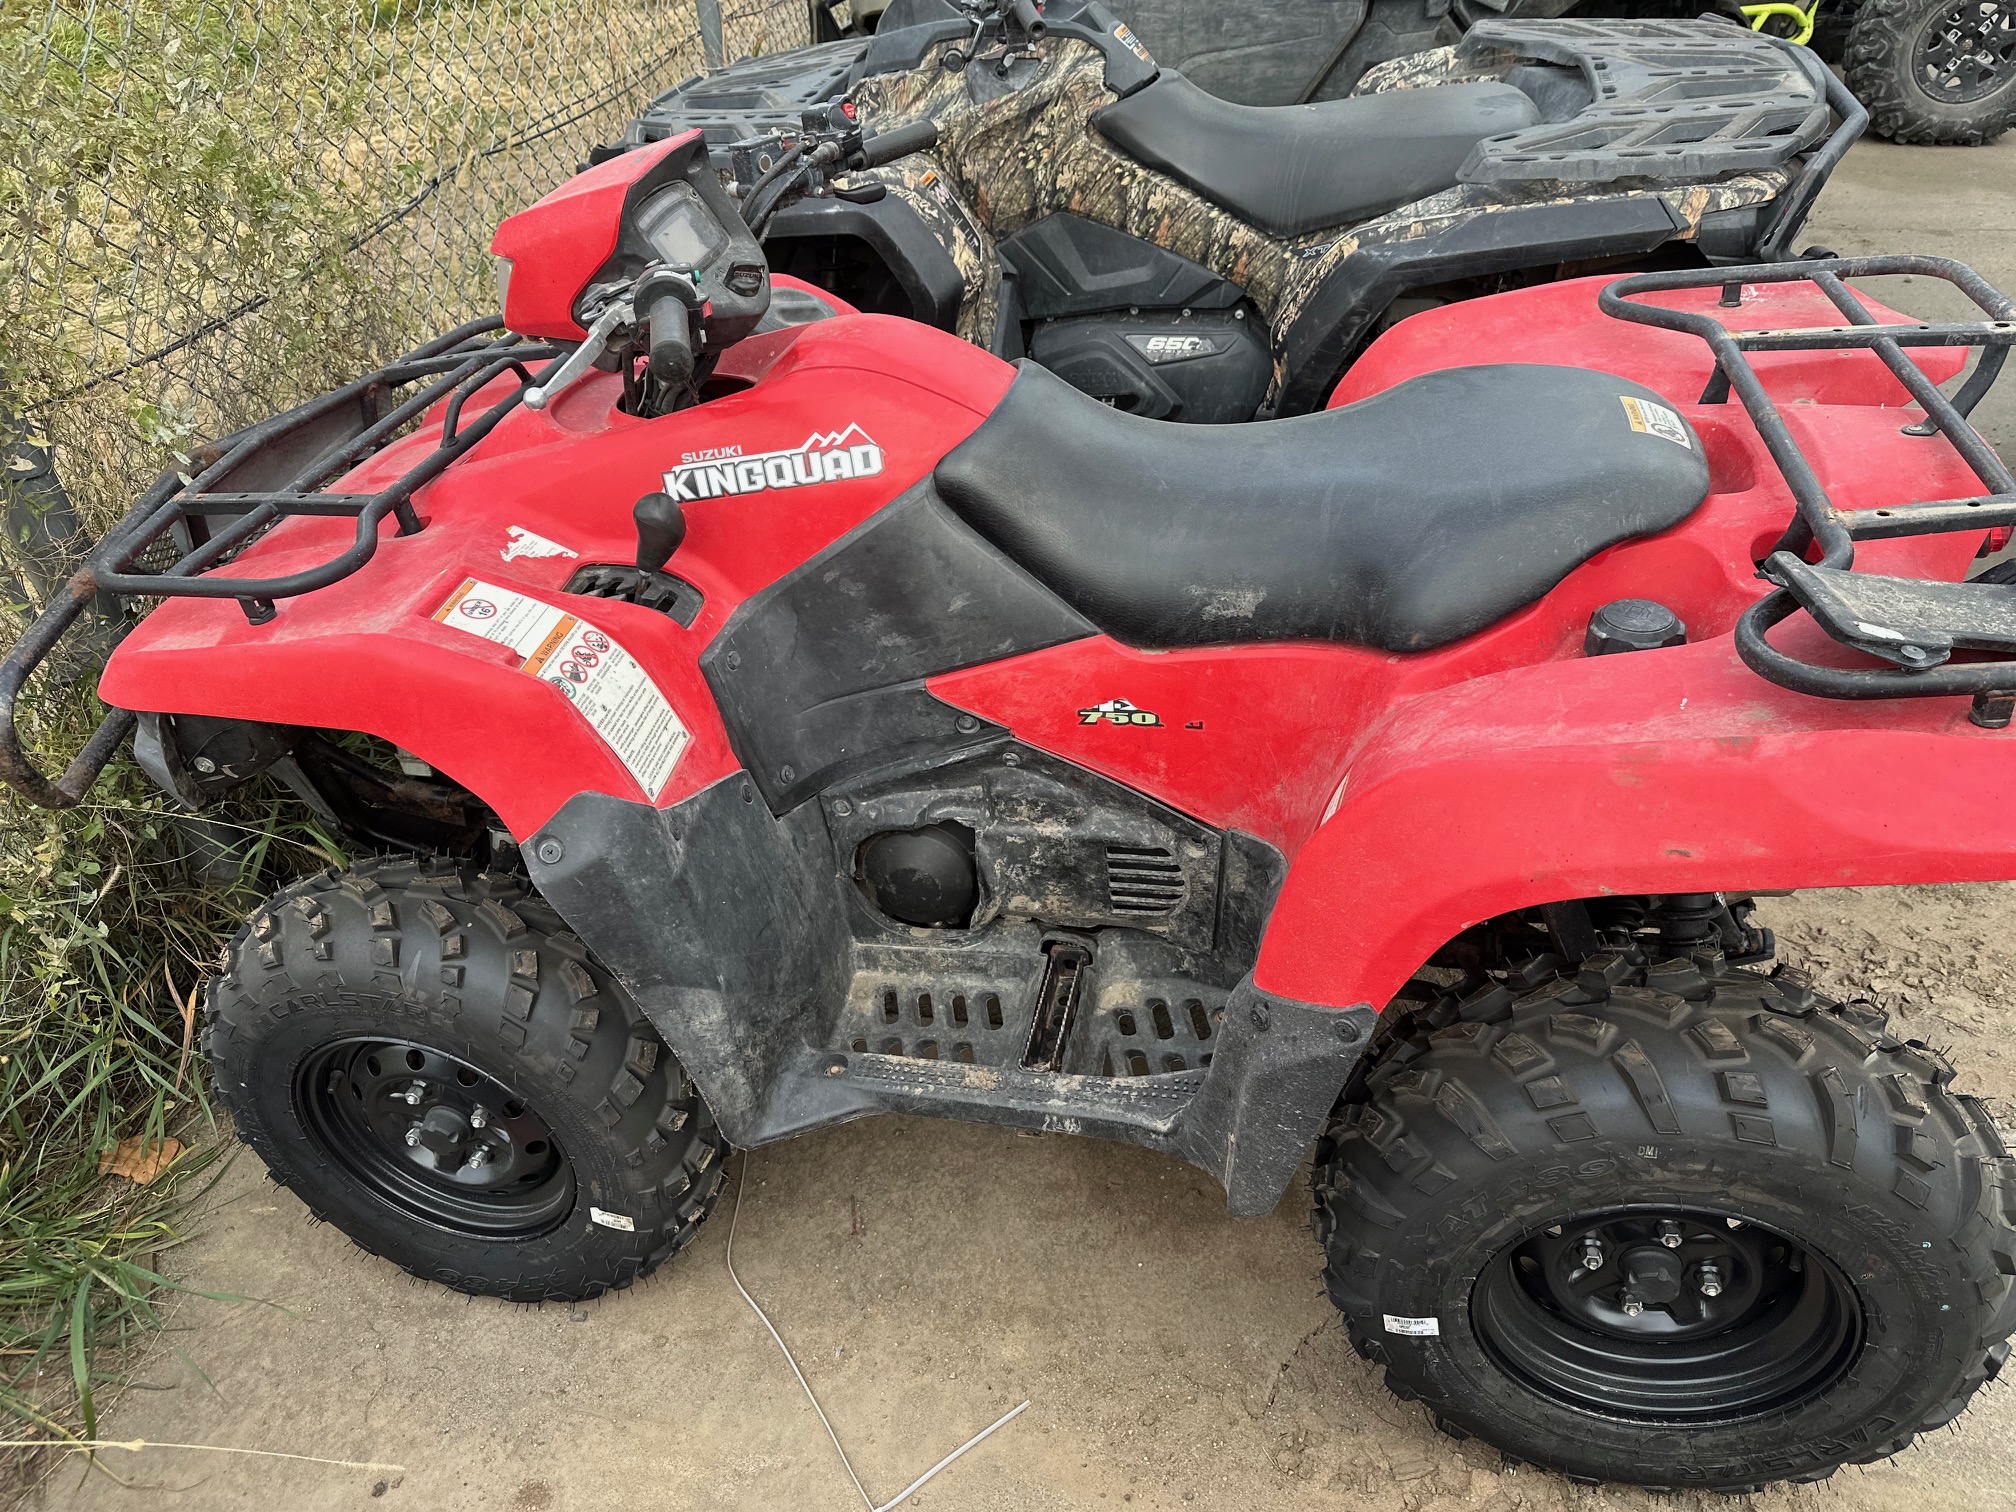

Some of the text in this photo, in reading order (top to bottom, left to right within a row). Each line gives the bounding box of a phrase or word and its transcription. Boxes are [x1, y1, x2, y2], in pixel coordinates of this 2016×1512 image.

[1146, 336, 1201, 350] 650
[681, 445, 743, 464] SUZUKI
[661, 442, 885, 503] KINGQUAD
[467, 600, 482, 616] UNDER
[479, 606, 491, 618] 16
[542, 631, 564, 652] WARNING
[1078, 710, 1160, 727] 750
[267, 991, 428, 1024] CARLSTAR
[1675, 1415, 1898, 1482] CARLSTAR
